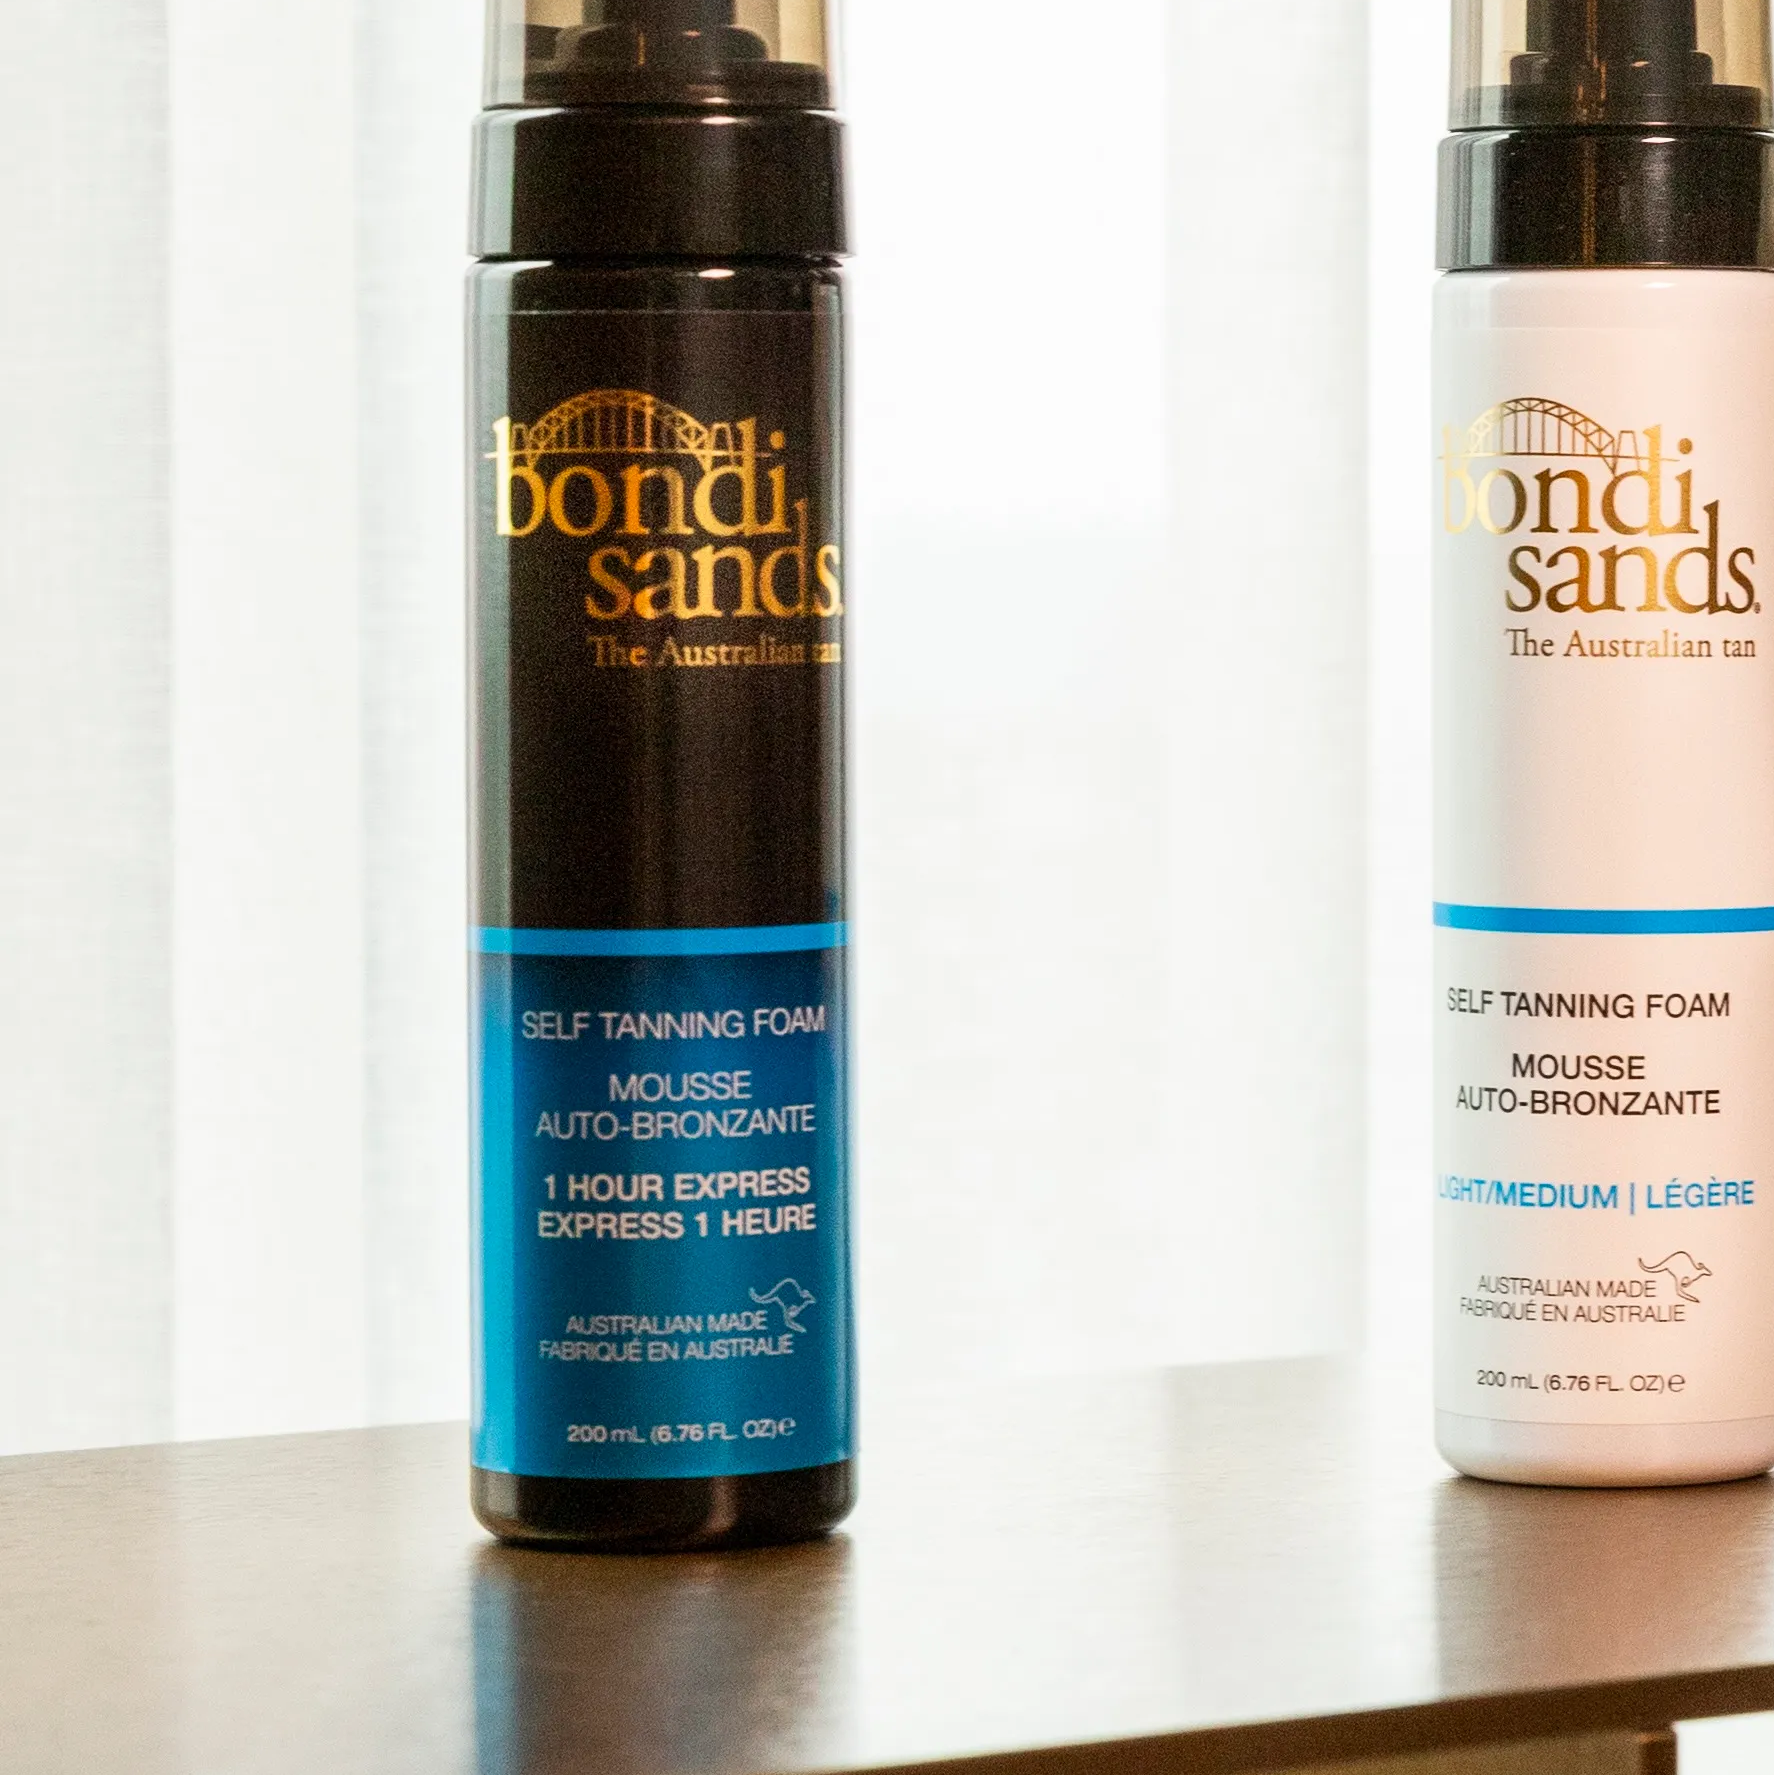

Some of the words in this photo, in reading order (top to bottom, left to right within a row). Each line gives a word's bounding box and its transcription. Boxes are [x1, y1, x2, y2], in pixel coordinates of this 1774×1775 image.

[493, 416, 791, 537] bondi
[1442, 421, 1699, 537] bondi
[587, 634, 648, 667] The
[658, 635, 804, 667] Australian
[1504, 628, 1554, 657] The
[1563, 628, 1712, 657] Australian
[1723, 637, 1756, 657] tan
[1447, 987, 1493, 1014] SELF
[1501, 991, 1634, 1019] TANNING
[1646, 992, 1730, 1018] FOAM
[522, 1010, 590, 1040] SELF
[598, 1010, 745, 1040] TANNING
[753, 1005, 826, 1036] FOAM
[1512, 1053, 1646, 1080] MOUSSE
[609, 1070, 752, 1102] MOUSSE
[1456, 1085, 1721, 1116] AUTO-BRONZANTE
[536, 1104, 816, 1141] AUTO-BRONZANTE
[544, 1174, 556, 1201] 1
[568, 1173, 664, 1202] HOUR
[674, 1166, 811, 1201] EXPRESS
[1646, 1176, 1756, 1209] LÉGÈRE
[537, 1210, 684, 1240] EXPRESS
[694, 1211, 708, 1238] 1
[722, 1203, 817, 1236] HEURE
[1477, 1276, 1591, 1299] AUSTRALIAN
[1596, 1279, 1658, 1298] MADE
[565, 1314, 702, 1336] AUSTRALIAN
[707, 1309, 768, 1332] MADE
[1460, 1296, 1537, 1322] FABRIQUÉ
[1542, 1303, 1568, 1322] EN
[1574, 1303, 1686, 1323] AUSTRALIE
[538, 1338, 642, 1362] FABRIQUÉ
[647, 1341, 680, 1362] EN
[1476, 1370, 1506, 1388] 200
[1511, 1374, 1539, 1390] mL
[1544, 1375, 1591, 1394] (6.76
[1595, 1375, 1625, 1392] FL.
[567, 1423, 607, 1443] 200
[610, 1425, 646, 1444] mL
[650, 1423, 705, 1446] (6.76
